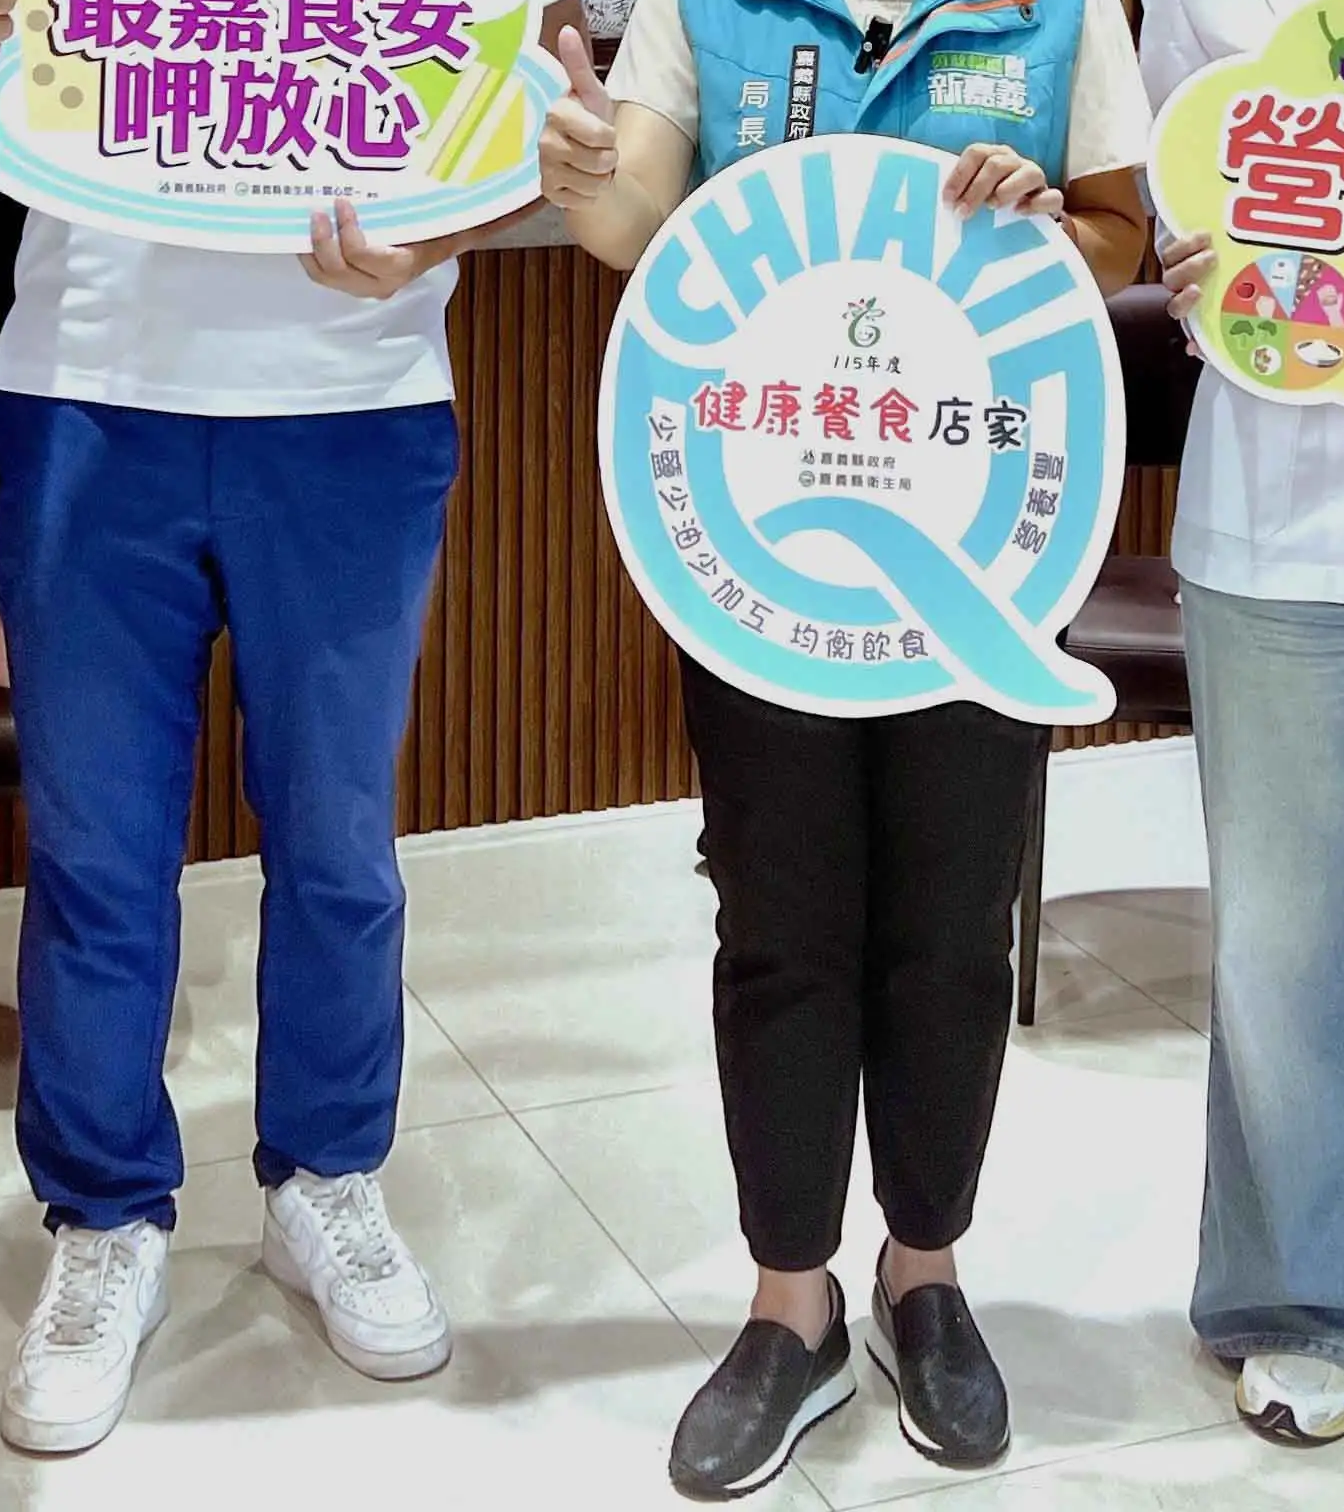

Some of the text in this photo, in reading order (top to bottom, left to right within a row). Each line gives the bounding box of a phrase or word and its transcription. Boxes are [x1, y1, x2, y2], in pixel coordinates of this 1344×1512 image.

[114, 59, 420, 158] 呷放心
[737, 81, 769, 147] 局長
[645, 150, 1077, 345] CHIAYI
[832, 354, 904, 375] 115年度
